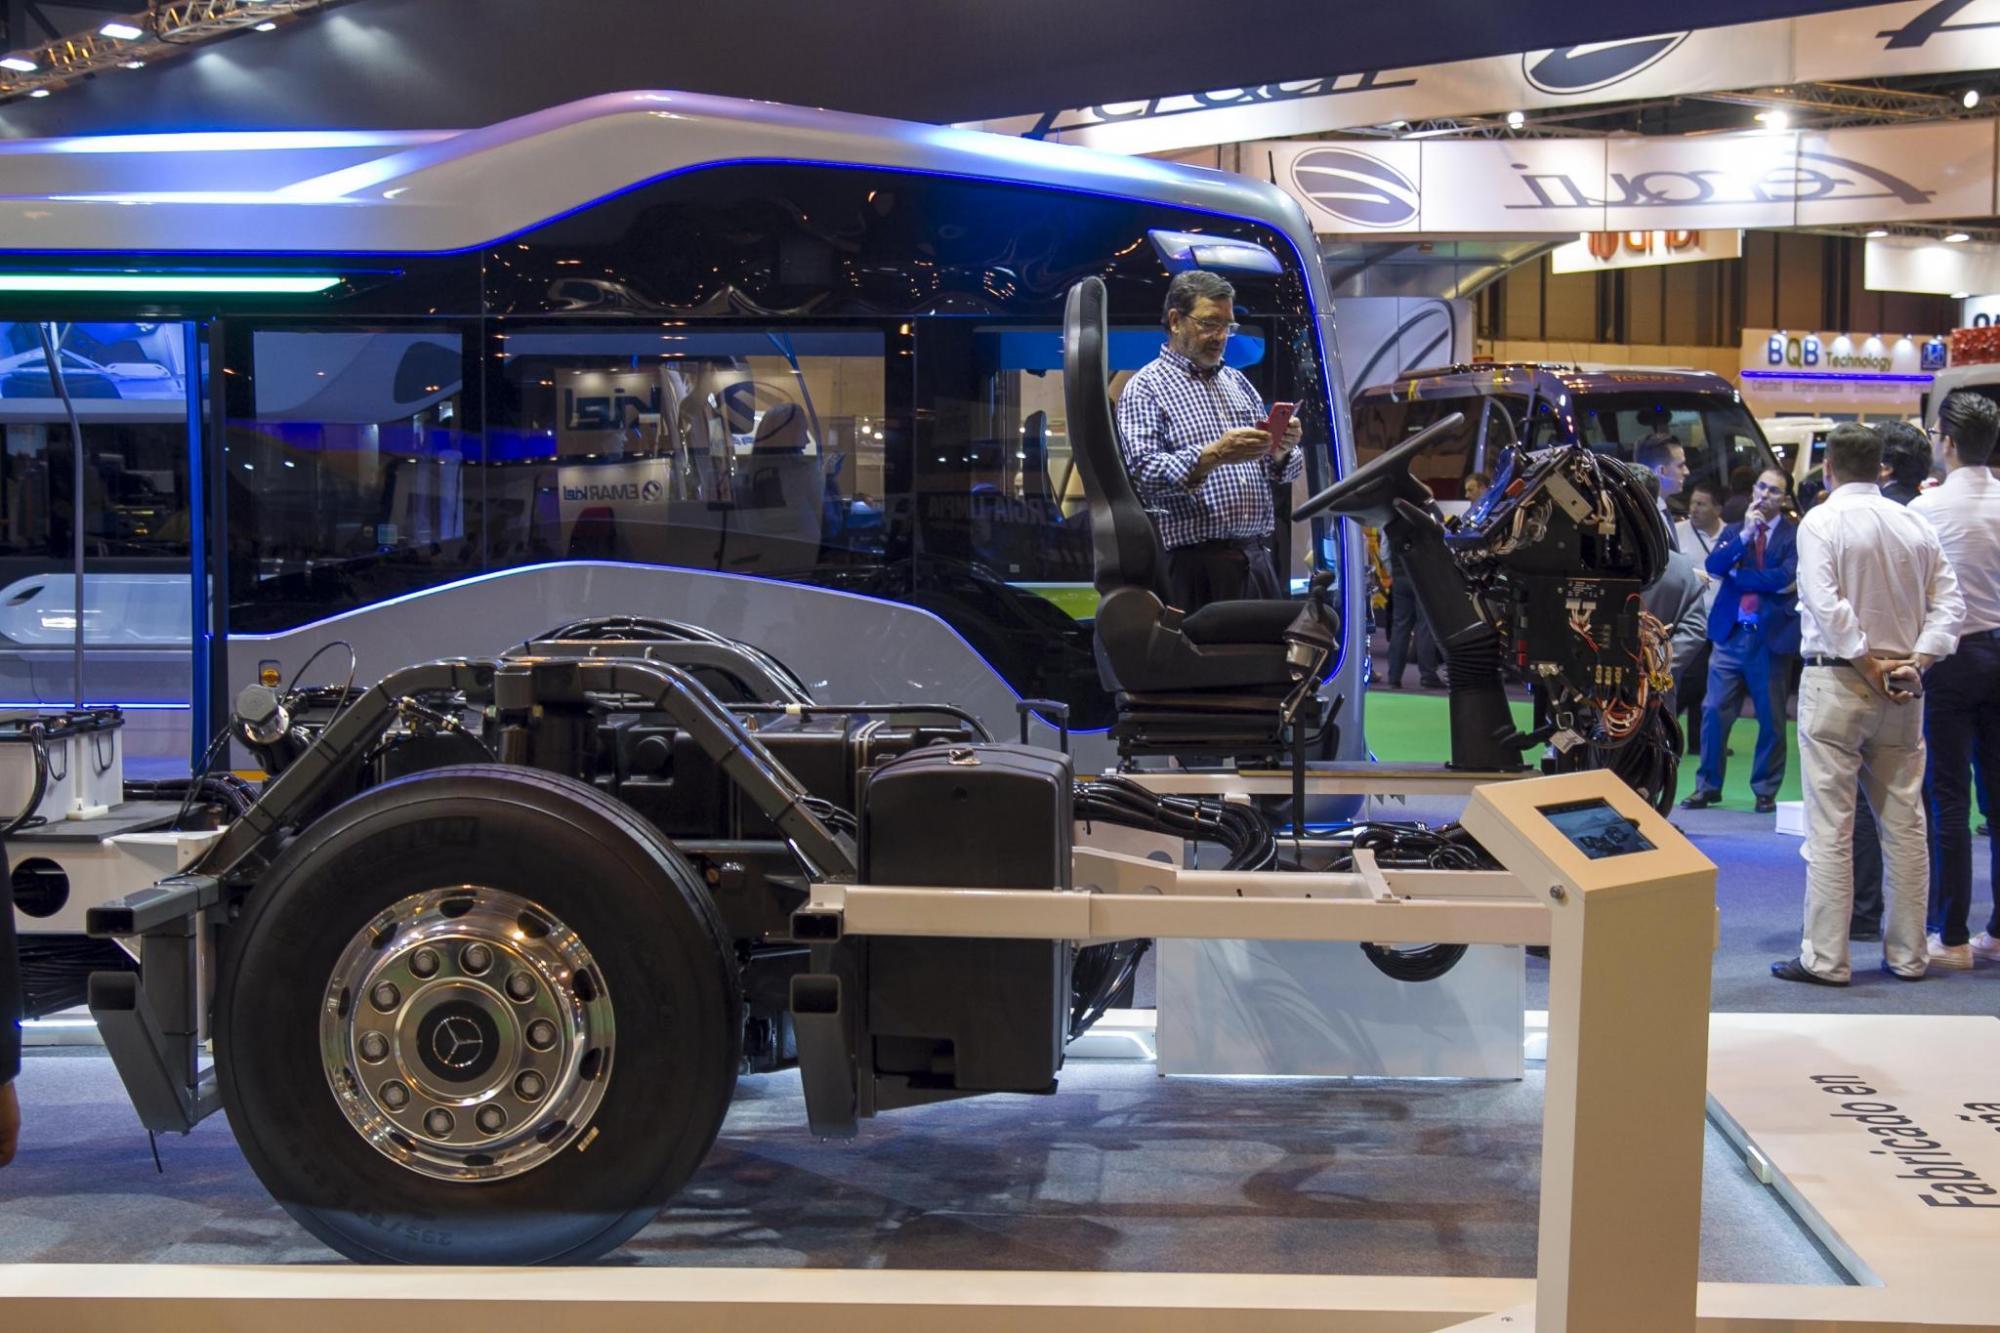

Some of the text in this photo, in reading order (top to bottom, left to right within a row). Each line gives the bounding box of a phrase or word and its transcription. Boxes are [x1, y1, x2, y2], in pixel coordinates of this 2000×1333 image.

[1767, 336, 1819, 368] BQB
[1826, 350, 1893, 372] Technology
[1808, 1074, 1878, 1096] en
[1829, 1102, 2000, 1209] Fabricado
